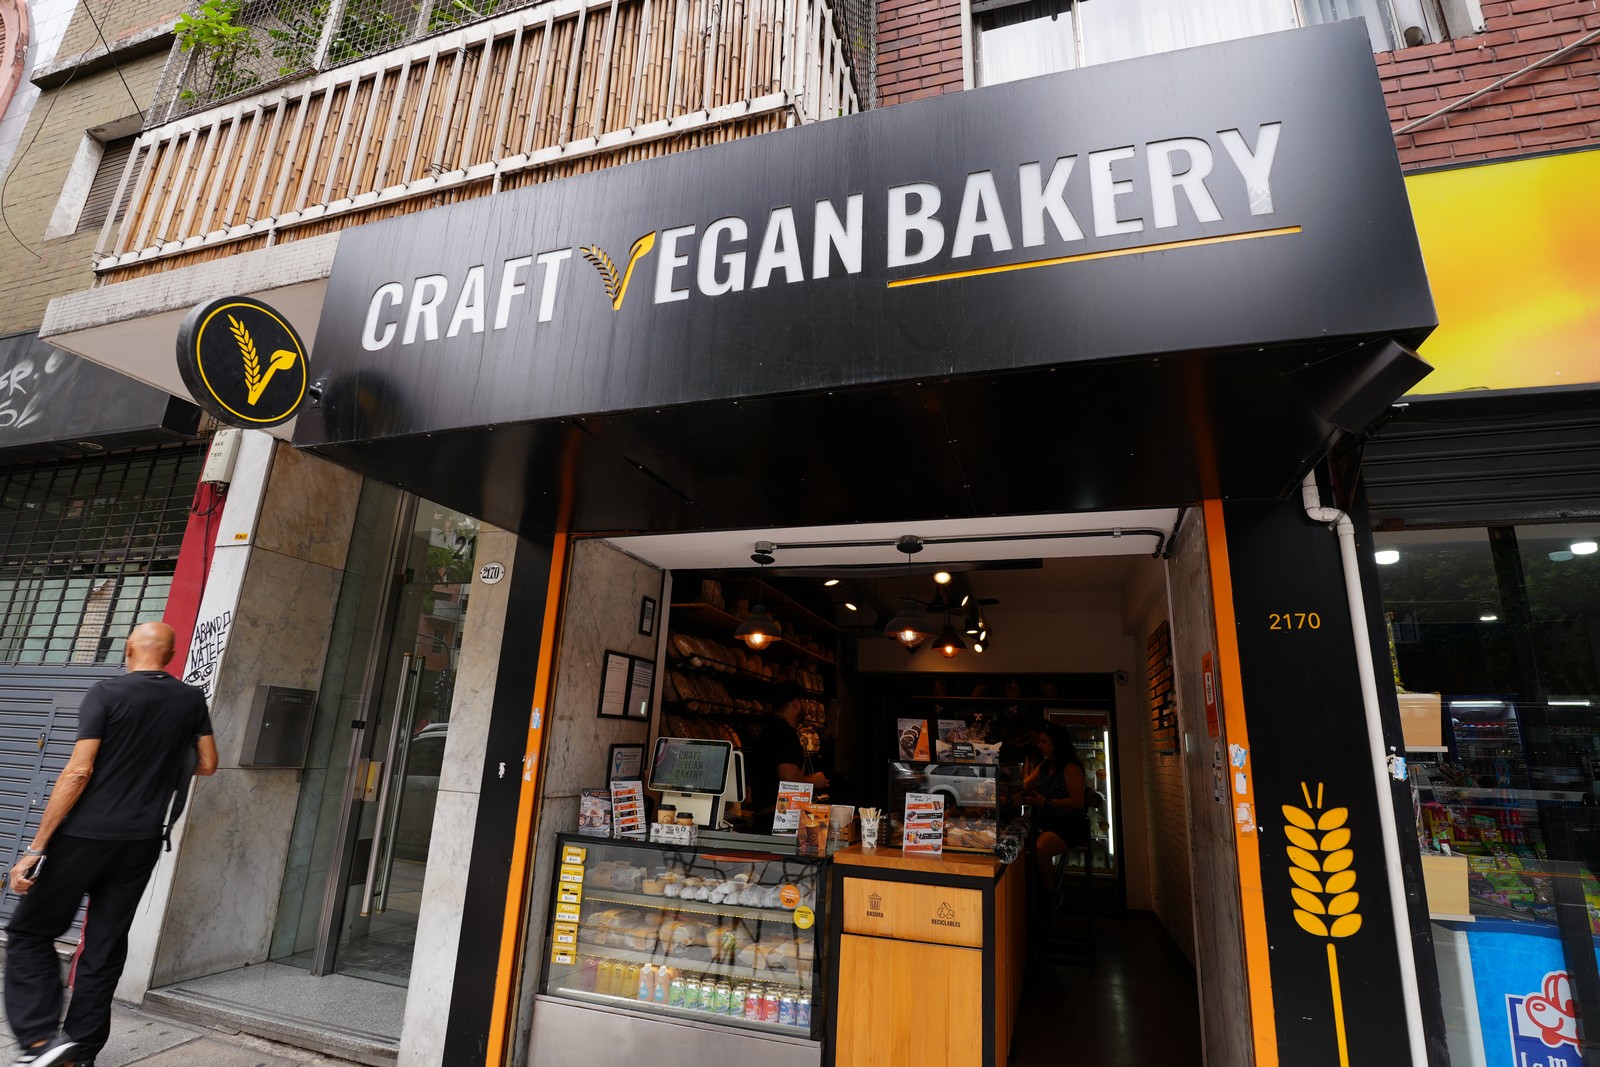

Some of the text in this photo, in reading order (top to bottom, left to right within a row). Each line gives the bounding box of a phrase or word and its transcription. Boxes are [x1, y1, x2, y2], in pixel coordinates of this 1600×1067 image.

[361, 247, 572, 352] CRAFT
[887, 121, 1283, 268] BAKERY
[481, 566, 500, 579] 2170
[1268, 612, 1321, 630] 2170
[674, 769, 704, 780] BAKERY
[866, 910, 884, 918] BASURA
[931, 918, 961, 928] RECICLABLES
